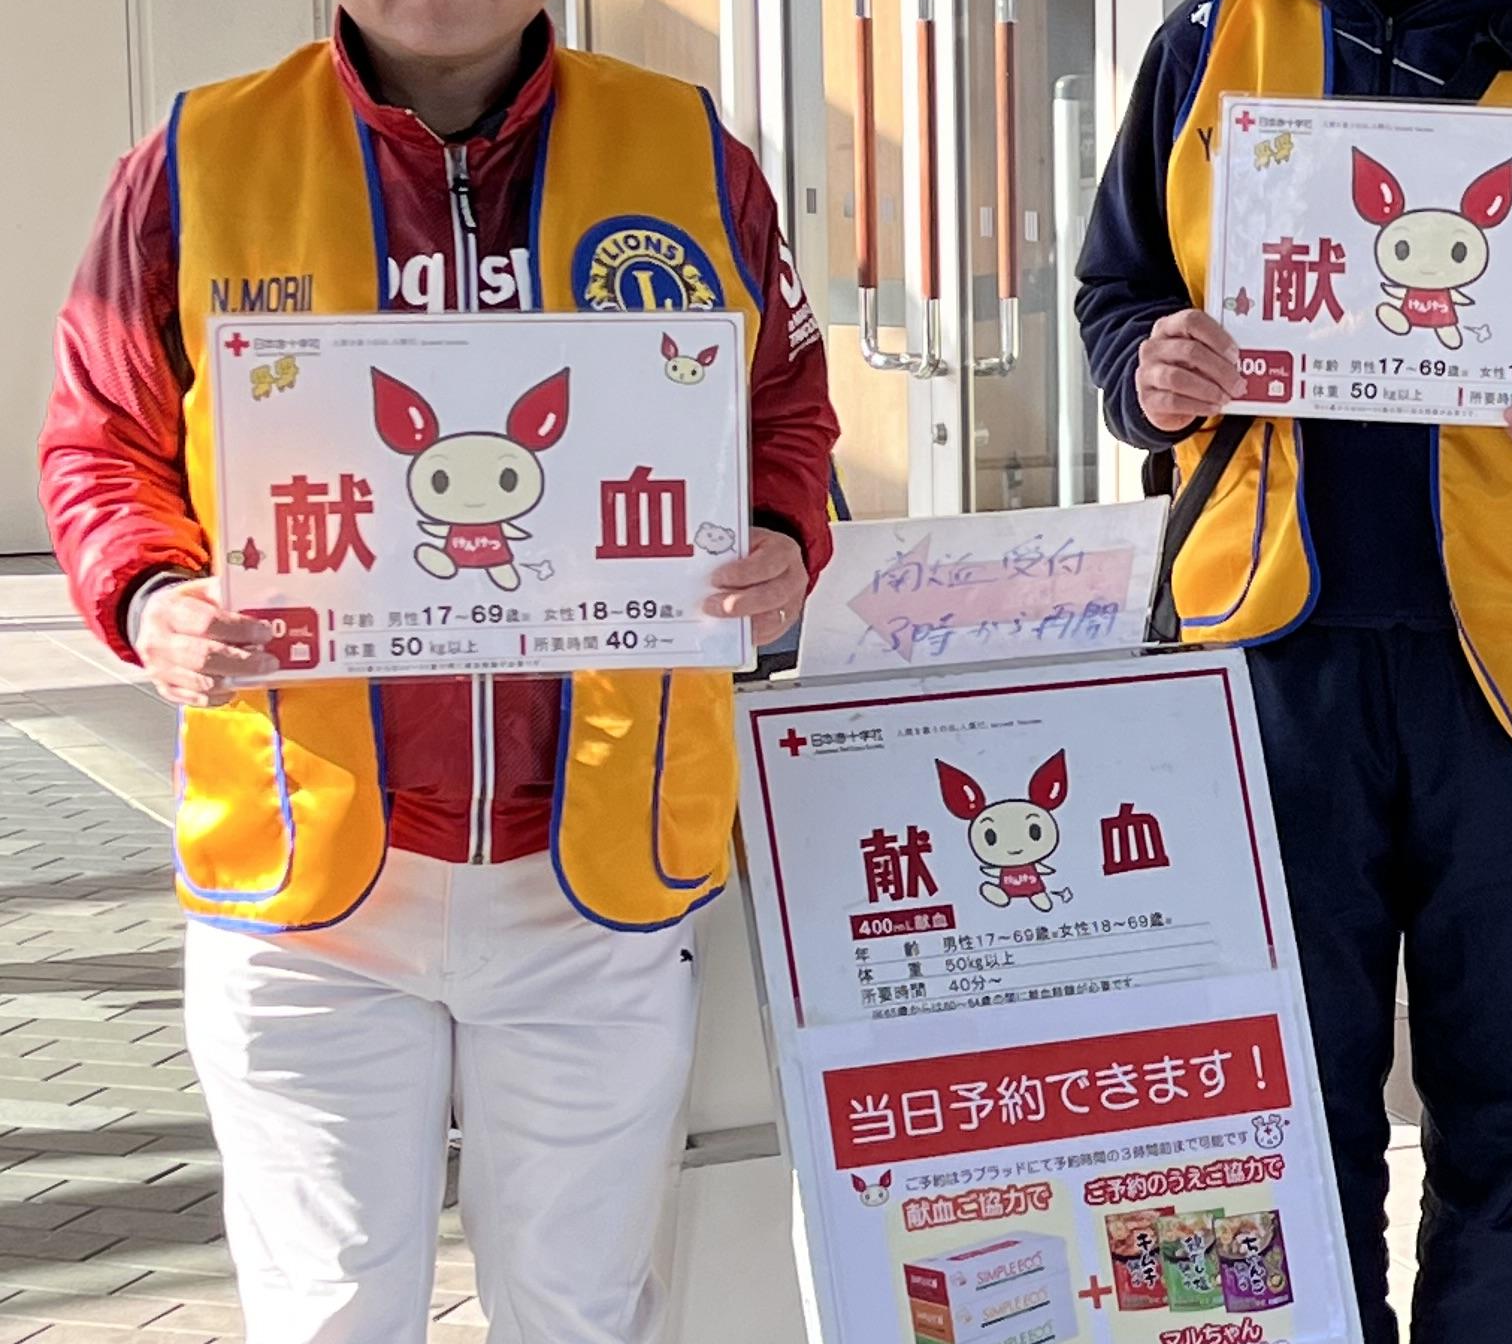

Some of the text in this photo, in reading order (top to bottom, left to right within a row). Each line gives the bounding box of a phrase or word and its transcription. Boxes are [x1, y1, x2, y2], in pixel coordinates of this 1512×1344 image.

[602, 233, 679, 264] LIONS
[1261, 236, 1347, 324] 献
[1350, 382, 1378, 400] 50
[270, 465, 694, 574] 献 血
[390, 636, 423, 657] 50
[606, 629, 638, 650] 40
[859, 802, 1171, 904] 献 血
[848, 1043, 1268, 1145] 当日予約できます！
[1083, 1154, 1286, 1207] ご予約のうえご協力で
[902, 1182, 1054, 1233] 献血ご協力で
